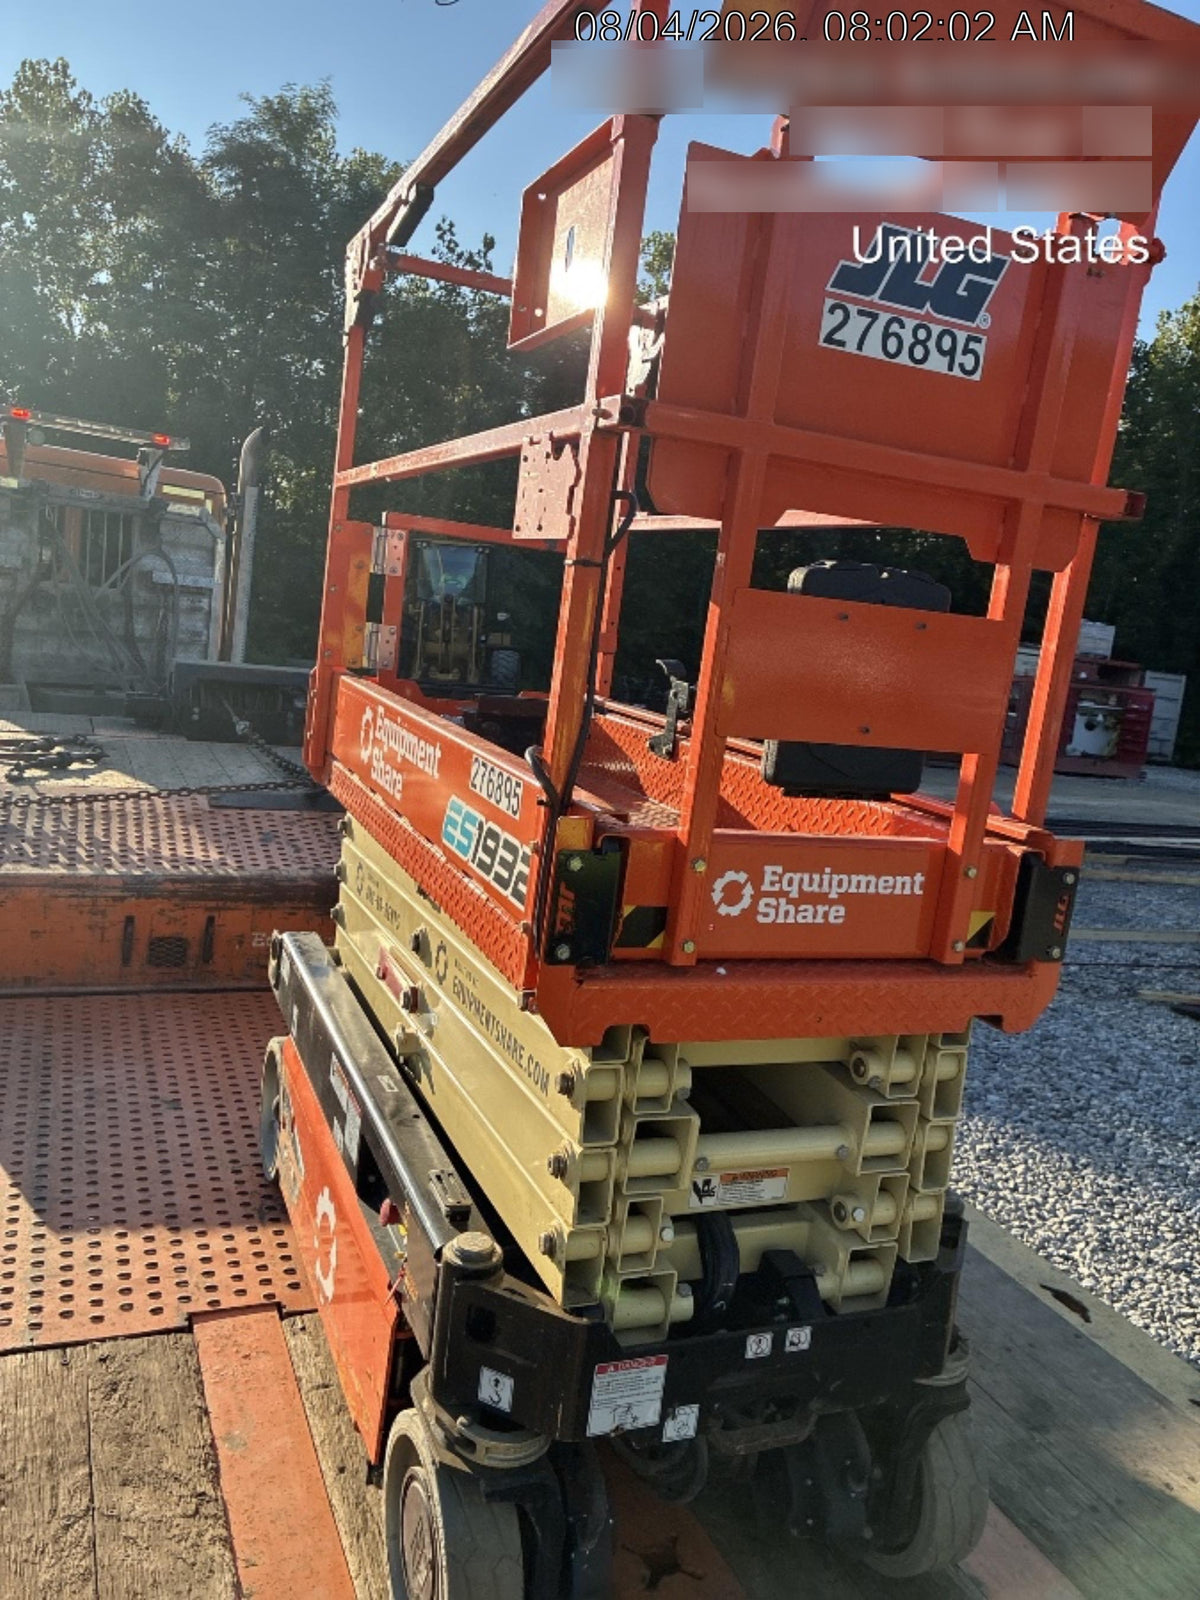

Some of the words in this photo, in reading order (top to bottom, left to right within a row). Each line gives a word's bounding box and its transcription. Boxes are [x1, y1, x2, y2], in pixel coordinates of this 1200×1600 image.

[823, 303, 983, 377] 276895
[374, 705, 442, 779] Equipment
[370, 746, 403, 801] Share
[470, 756, 521, 817] 276895
[756, 897, 846, 924] Share
[760, 865, 925, 898] Equipment
